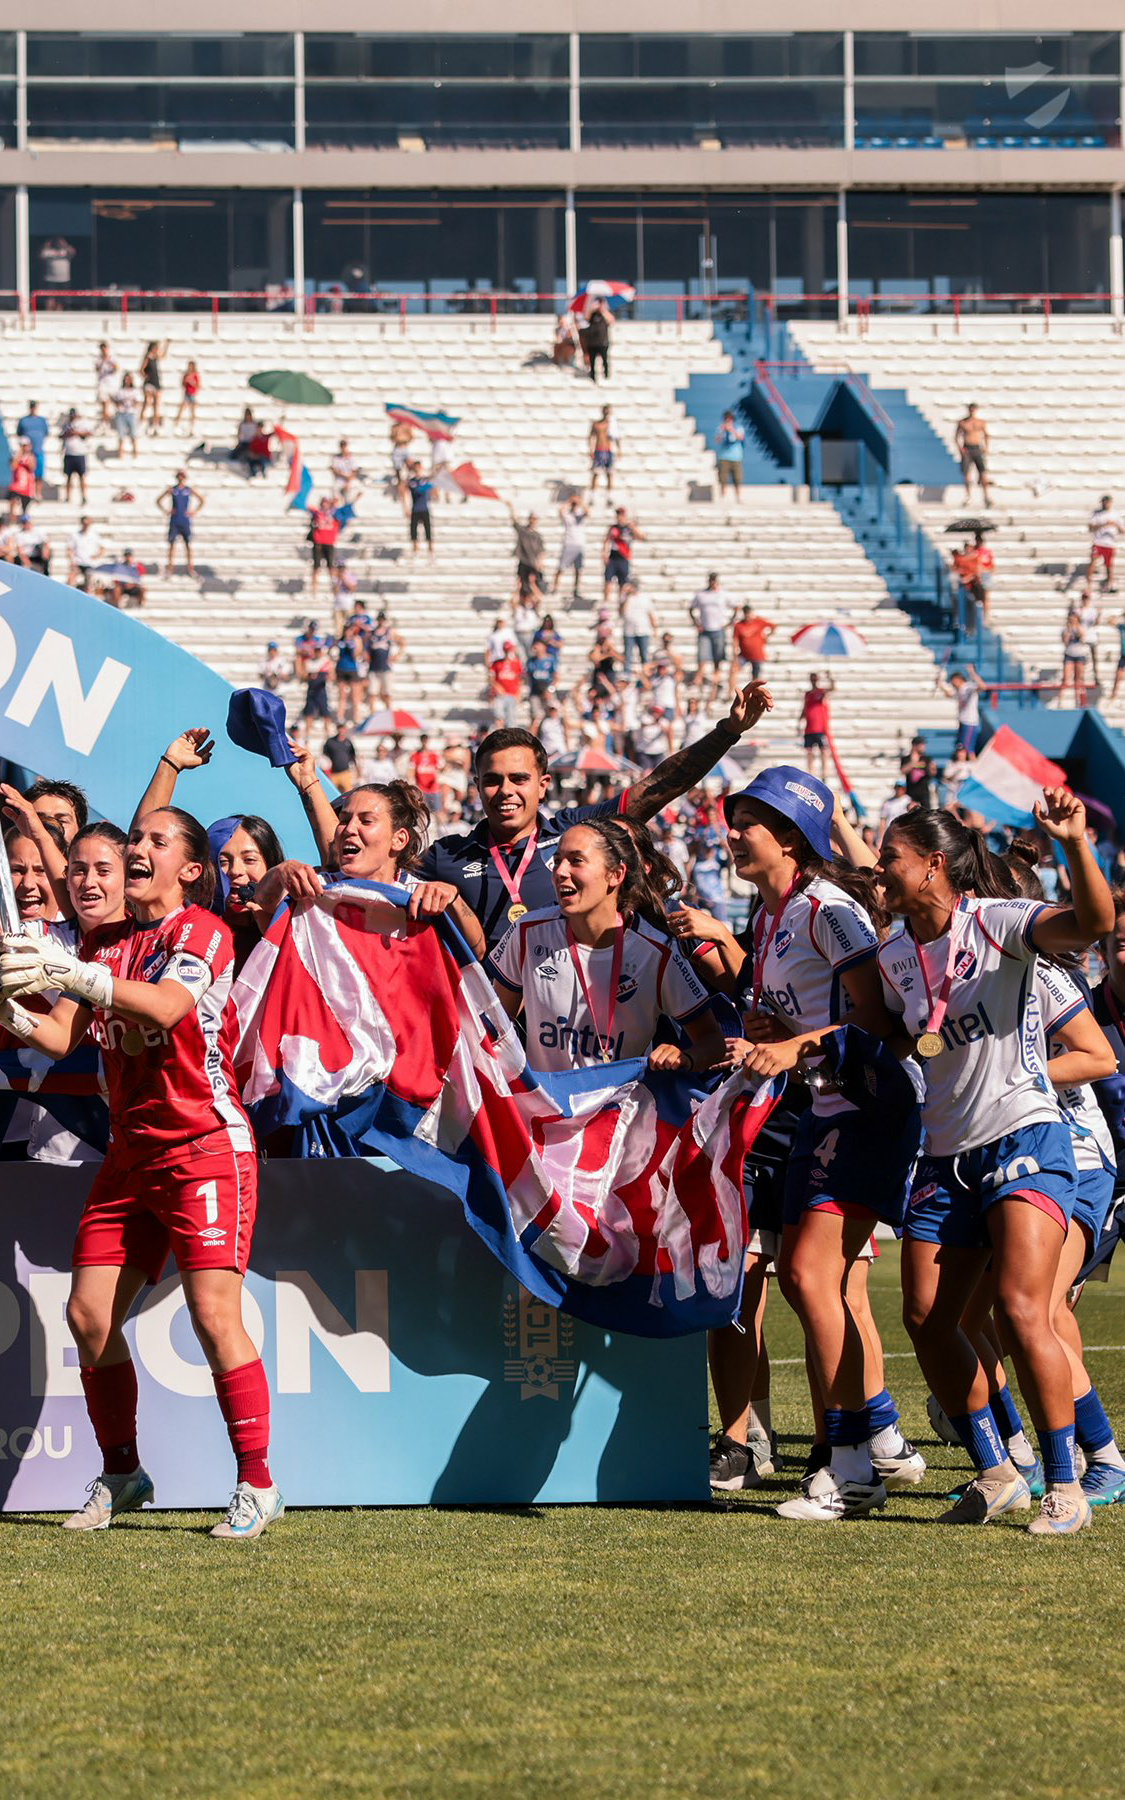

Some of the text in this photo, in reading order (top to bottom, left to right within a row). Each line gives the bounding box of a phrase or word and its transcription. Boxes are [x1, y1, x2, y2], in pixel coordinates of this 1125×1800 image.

[820, 904, 854, 953] SARUBBI
[672, 953, 704, 1000] SARUBBI
[1036, 969, 1068, 1006] ARUBBI
[540, 1016, 624, 1062] antel
[813, 1128, 840, 1168] 4
[196, 1180, 218, 1224] 1
